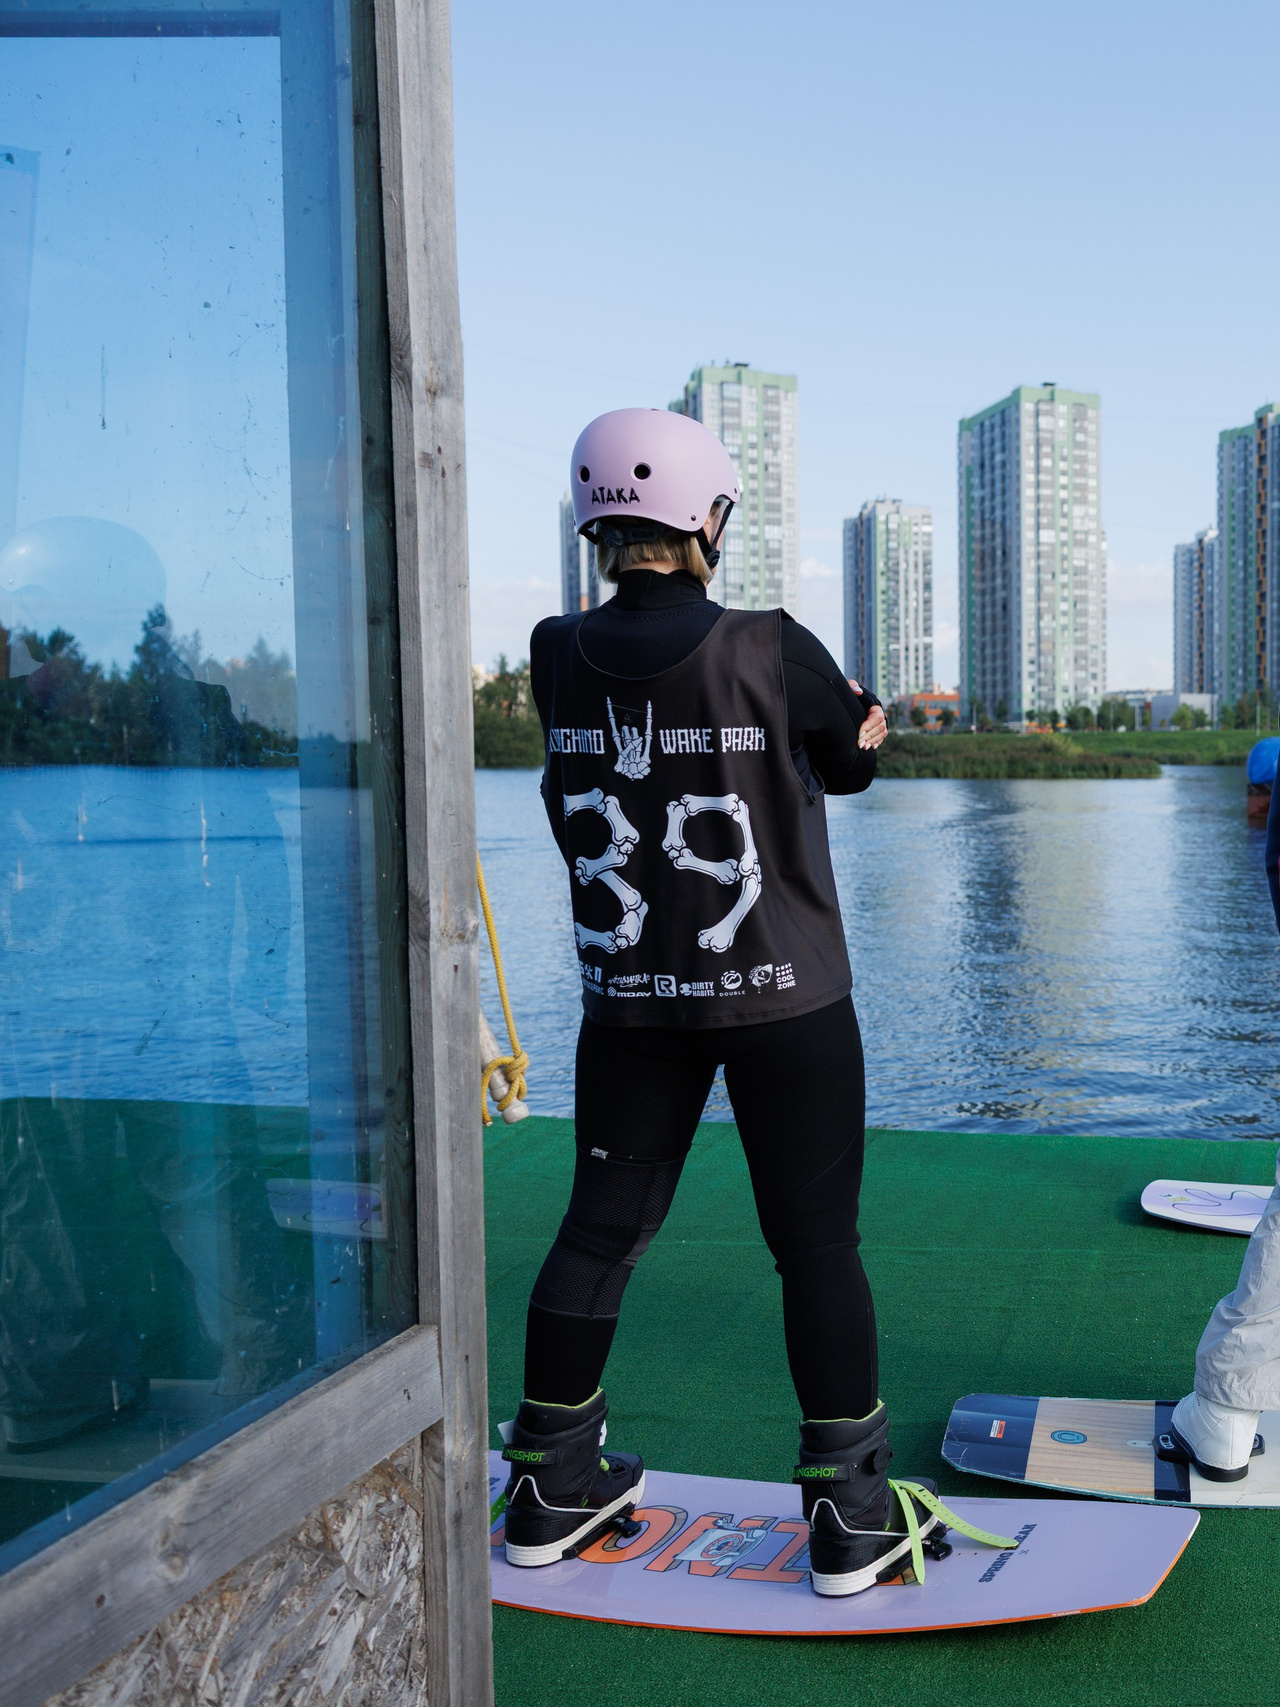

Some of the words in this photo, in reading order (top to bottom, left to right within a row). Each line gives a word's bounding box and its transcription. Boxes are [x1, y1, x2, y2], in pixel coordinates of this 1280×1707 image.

[659, 728, 714, 754] WAKE
[720, 727, 766, 753] PARK
[563, 787, 762, 954] 39
[776, 974, 795, 984] COOL
[692, 981, 714, 990] DIRTY
[777, 981, 796, 990] ZONE
[692, 989, 715, 997] HABITS
[719, 989, 746, 997] DOUBLE
[978, 1551, 1014, 1583] SPRING
